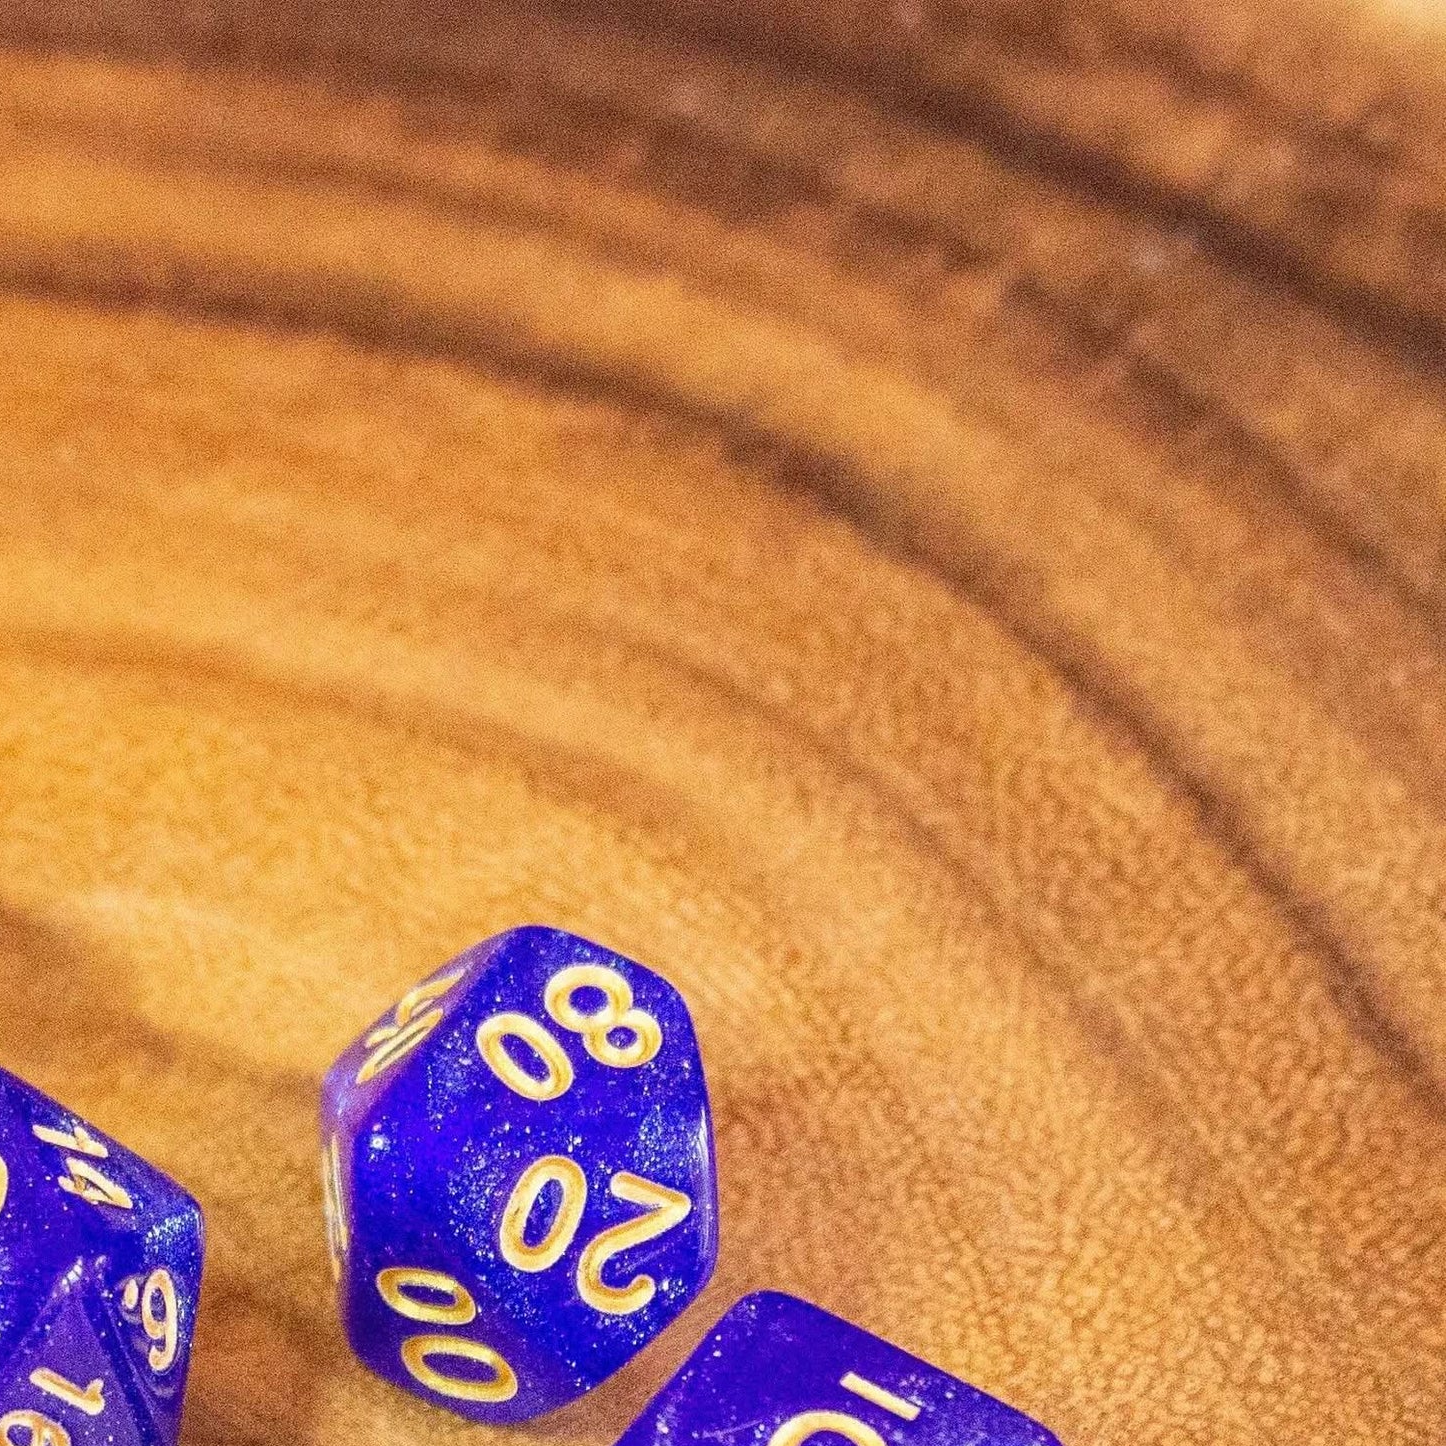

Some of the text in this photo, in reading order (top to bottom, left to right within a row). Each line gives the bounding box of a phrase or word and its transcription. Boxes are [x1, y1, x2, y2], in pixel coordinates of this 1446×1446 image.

[476, 964, 663, 1101] 80
[32, 1123, 135, 1210] 14
[499, 1154, 693, 1317] 20
[376, 1267, 519, 1402] 00
